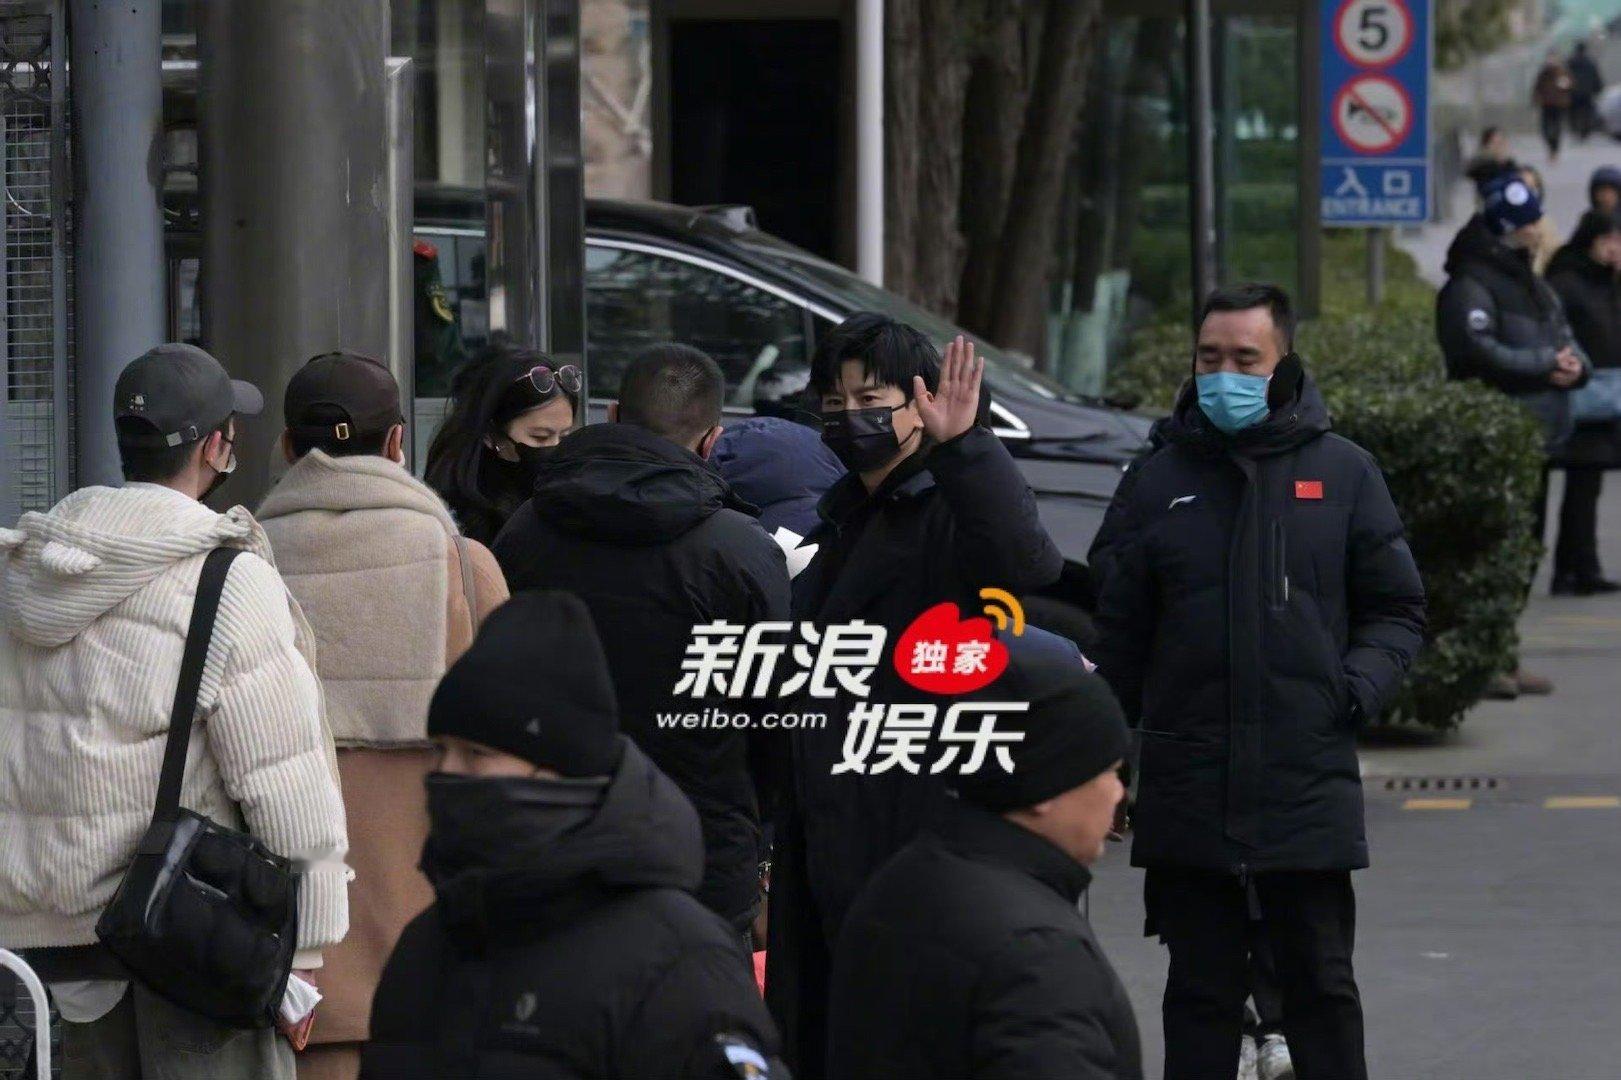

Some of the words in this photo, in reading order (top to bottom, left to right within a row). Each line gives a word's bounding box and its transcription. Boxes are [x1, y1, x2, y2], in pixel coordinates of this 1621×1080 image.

[1358, 7, 1389, 50] 5
[1335, 166, 1411, 197] 入口
[1320, 198, 1420, 218] ENTRANCE
